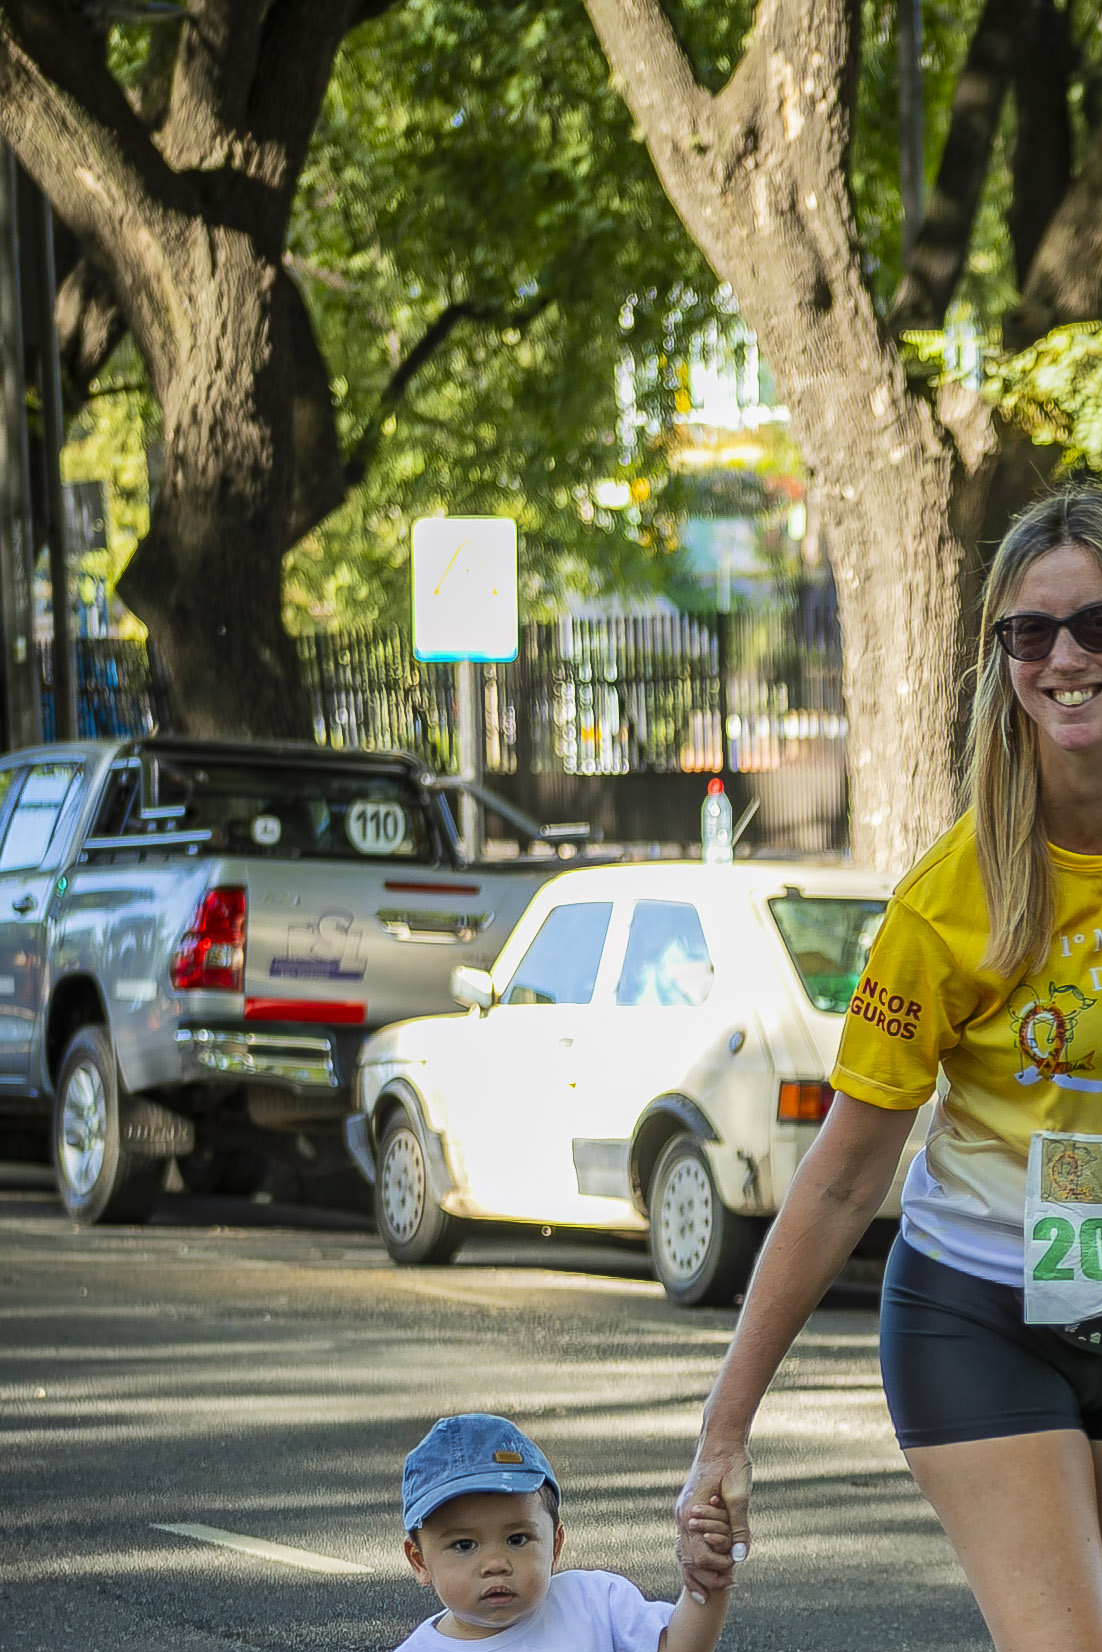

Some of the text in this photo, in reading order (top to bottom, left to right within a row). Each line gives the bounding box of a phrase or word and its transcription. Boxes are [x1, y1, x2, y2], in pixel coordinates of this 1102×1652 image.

[357, 810, 398, 842] 110
[851, 996, 917, 1040] GUROS
[857, 977, 922, 1021] NCOR
